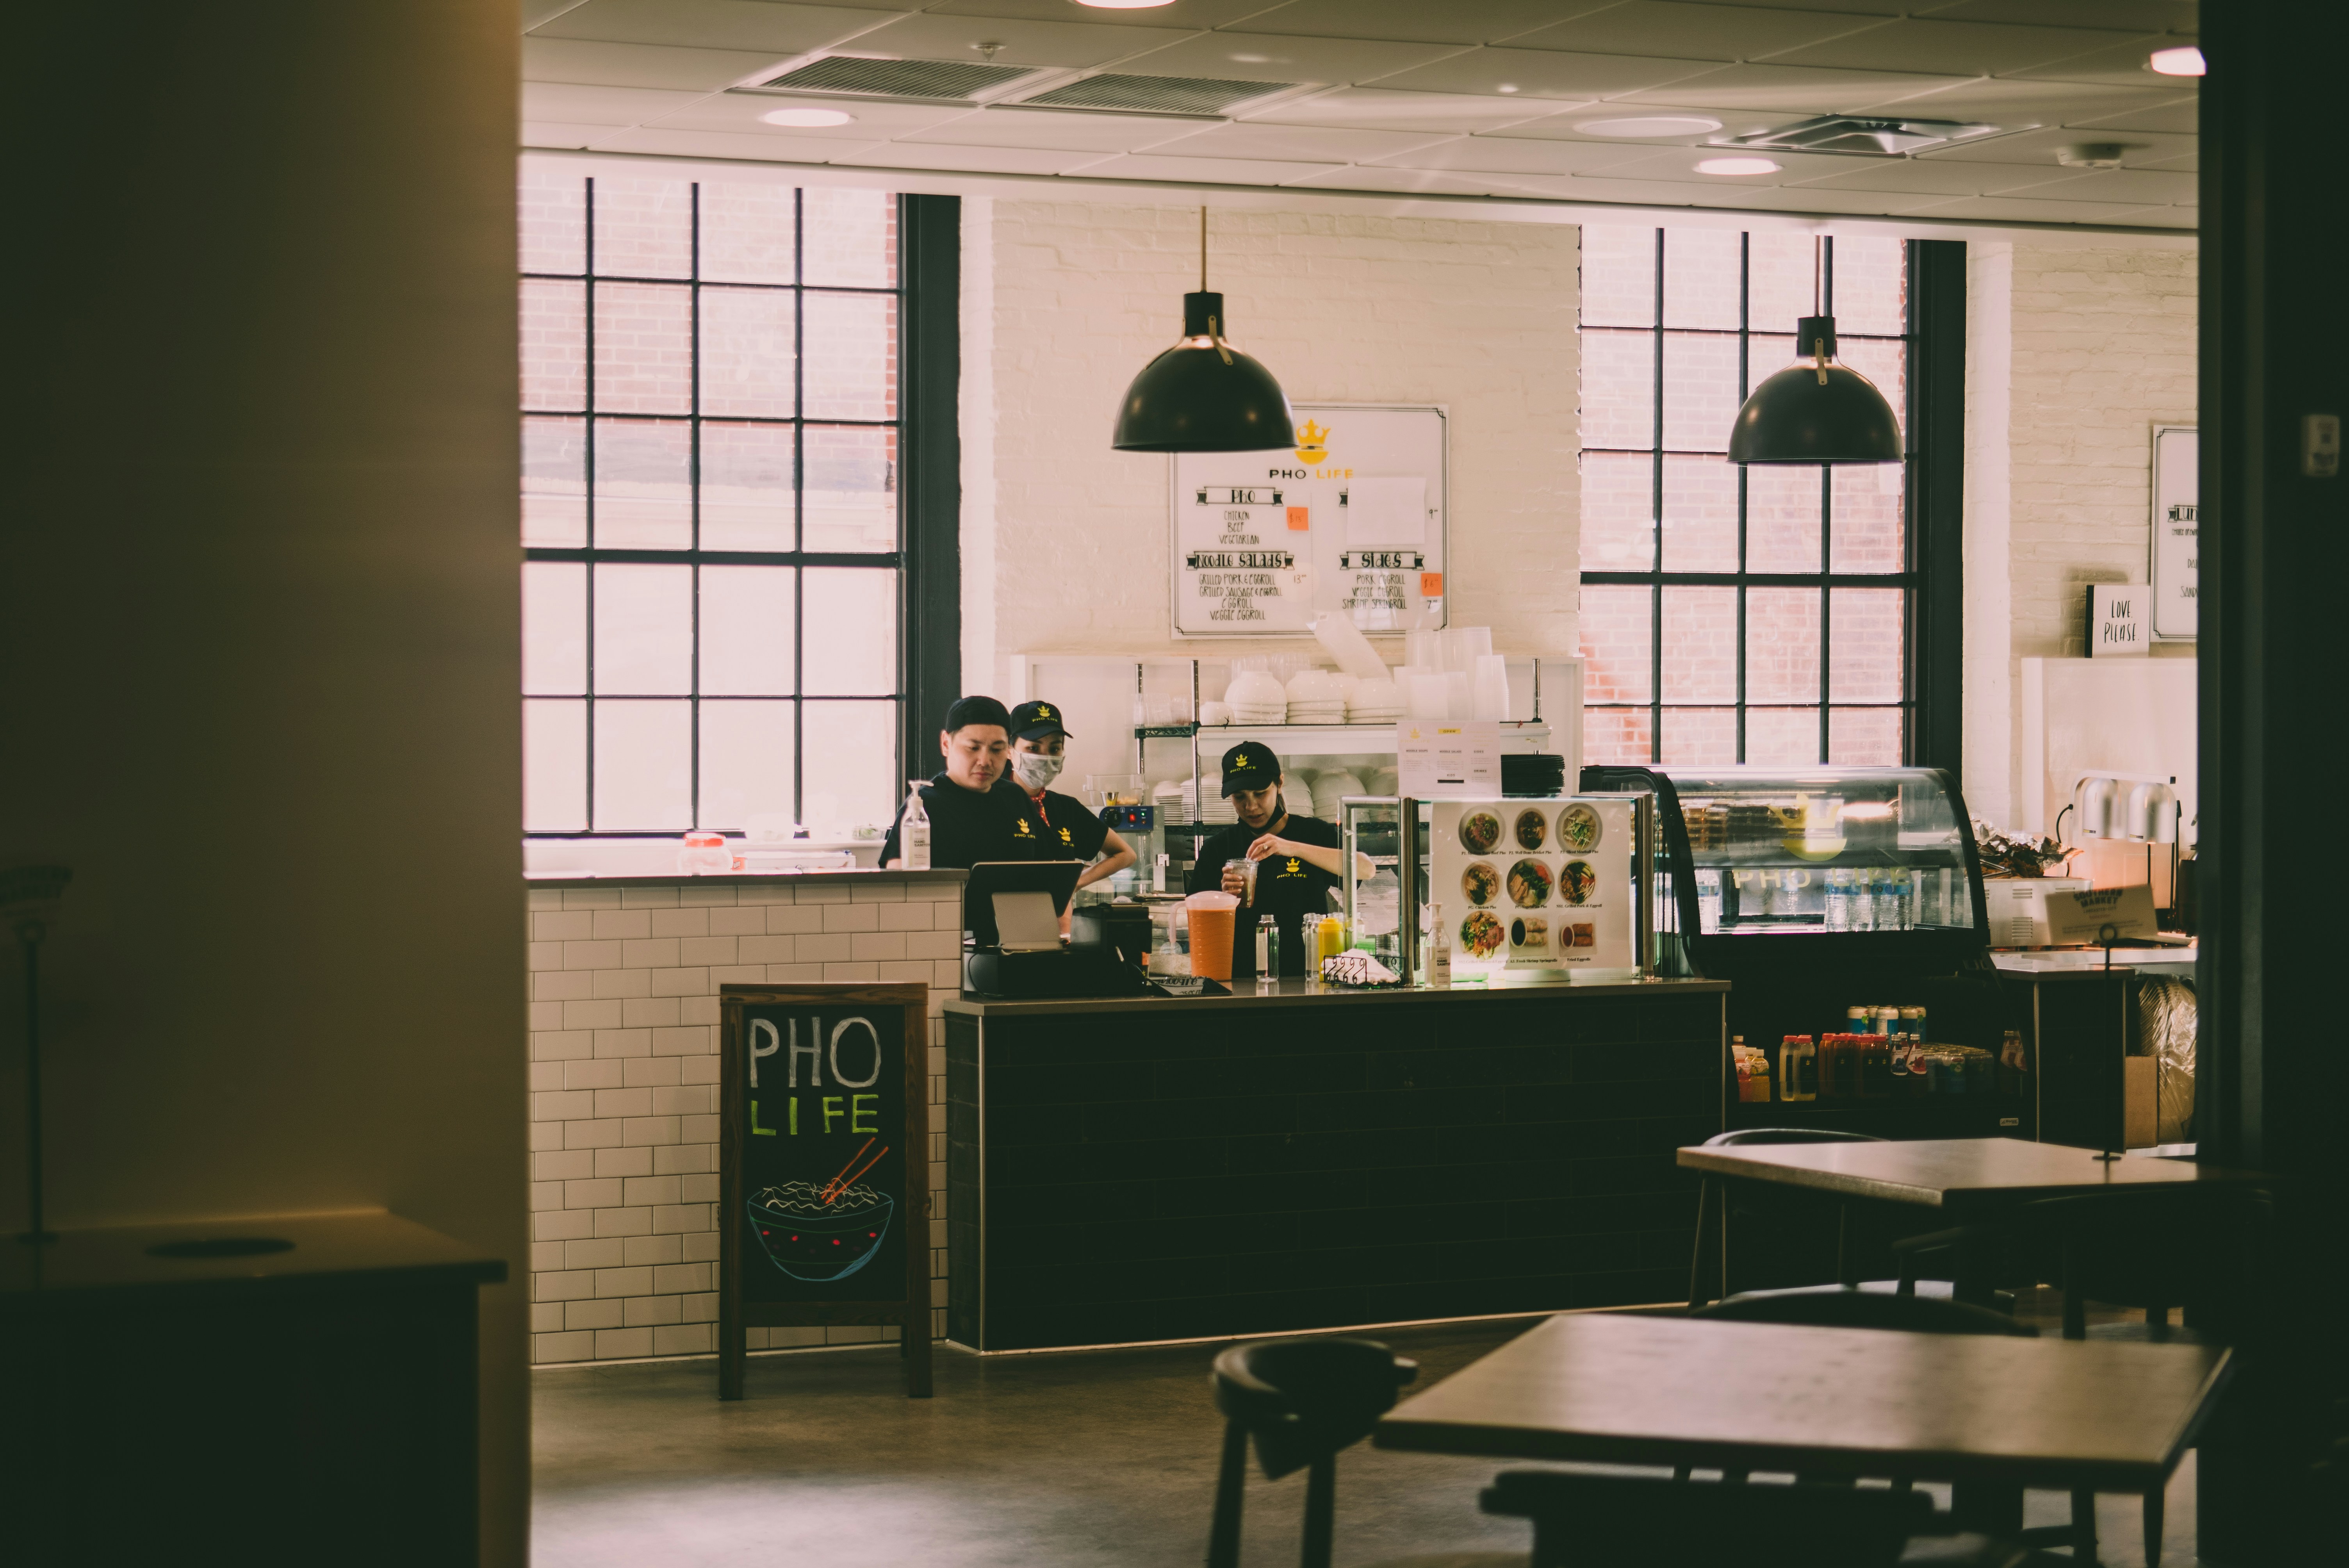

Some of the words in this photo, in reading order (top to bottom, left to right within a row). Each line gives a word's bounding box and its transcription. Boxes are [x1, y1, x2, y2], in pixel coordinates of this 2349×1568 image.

[1270, 470, 1306, 479] PHO
[1316, 469, 1353, 479] LIFE
[1224, 511, 1250, 520] CHICKEN
[1228, 522, 1244, 533] BEEF
[1219, 535, 1260, 544] VEGETARIAN
[1199, 574, 1222, 585] GRILLED
[1224, 574, 1244, 585] PORK
[1244, 574, 1248, 583] &
[1249, 574, 1276, 585] EGGROLL
[1357, 574, 1376, 584] PORK
[1379, 574, 1406, 584] EGGROLL
[1199, 586, 1224, 597] GRILLED
[1226, 586, 1254, 597] SAUSAGE
[1260, 587, 1283, 597] EGGROLL
[1352, 587, 1373, 597] VEGGIE
[1378, 586, 1405, 597] EGGROLL
[1222, 598, 1254, 609] EGGROLL
[1342, 599, 1369, 609] SHRIMP
[1372, 599, 1408, 609] SPRINGROLL
[1210, 610, 1235, 620] VEGGIE
[1237, 609, 1266, 620] EGGROLL
[1733, 868, 1811, 889] PHO
[1831, 866, 1910, 887] LIFE
[2073, 888, 2123, 902] SOUTHERN
[2080, 897, 2118, 908] MARKET
[749, 1017, 882, 1089] PHO
[751, 1094, 879, 1136] LIFE
